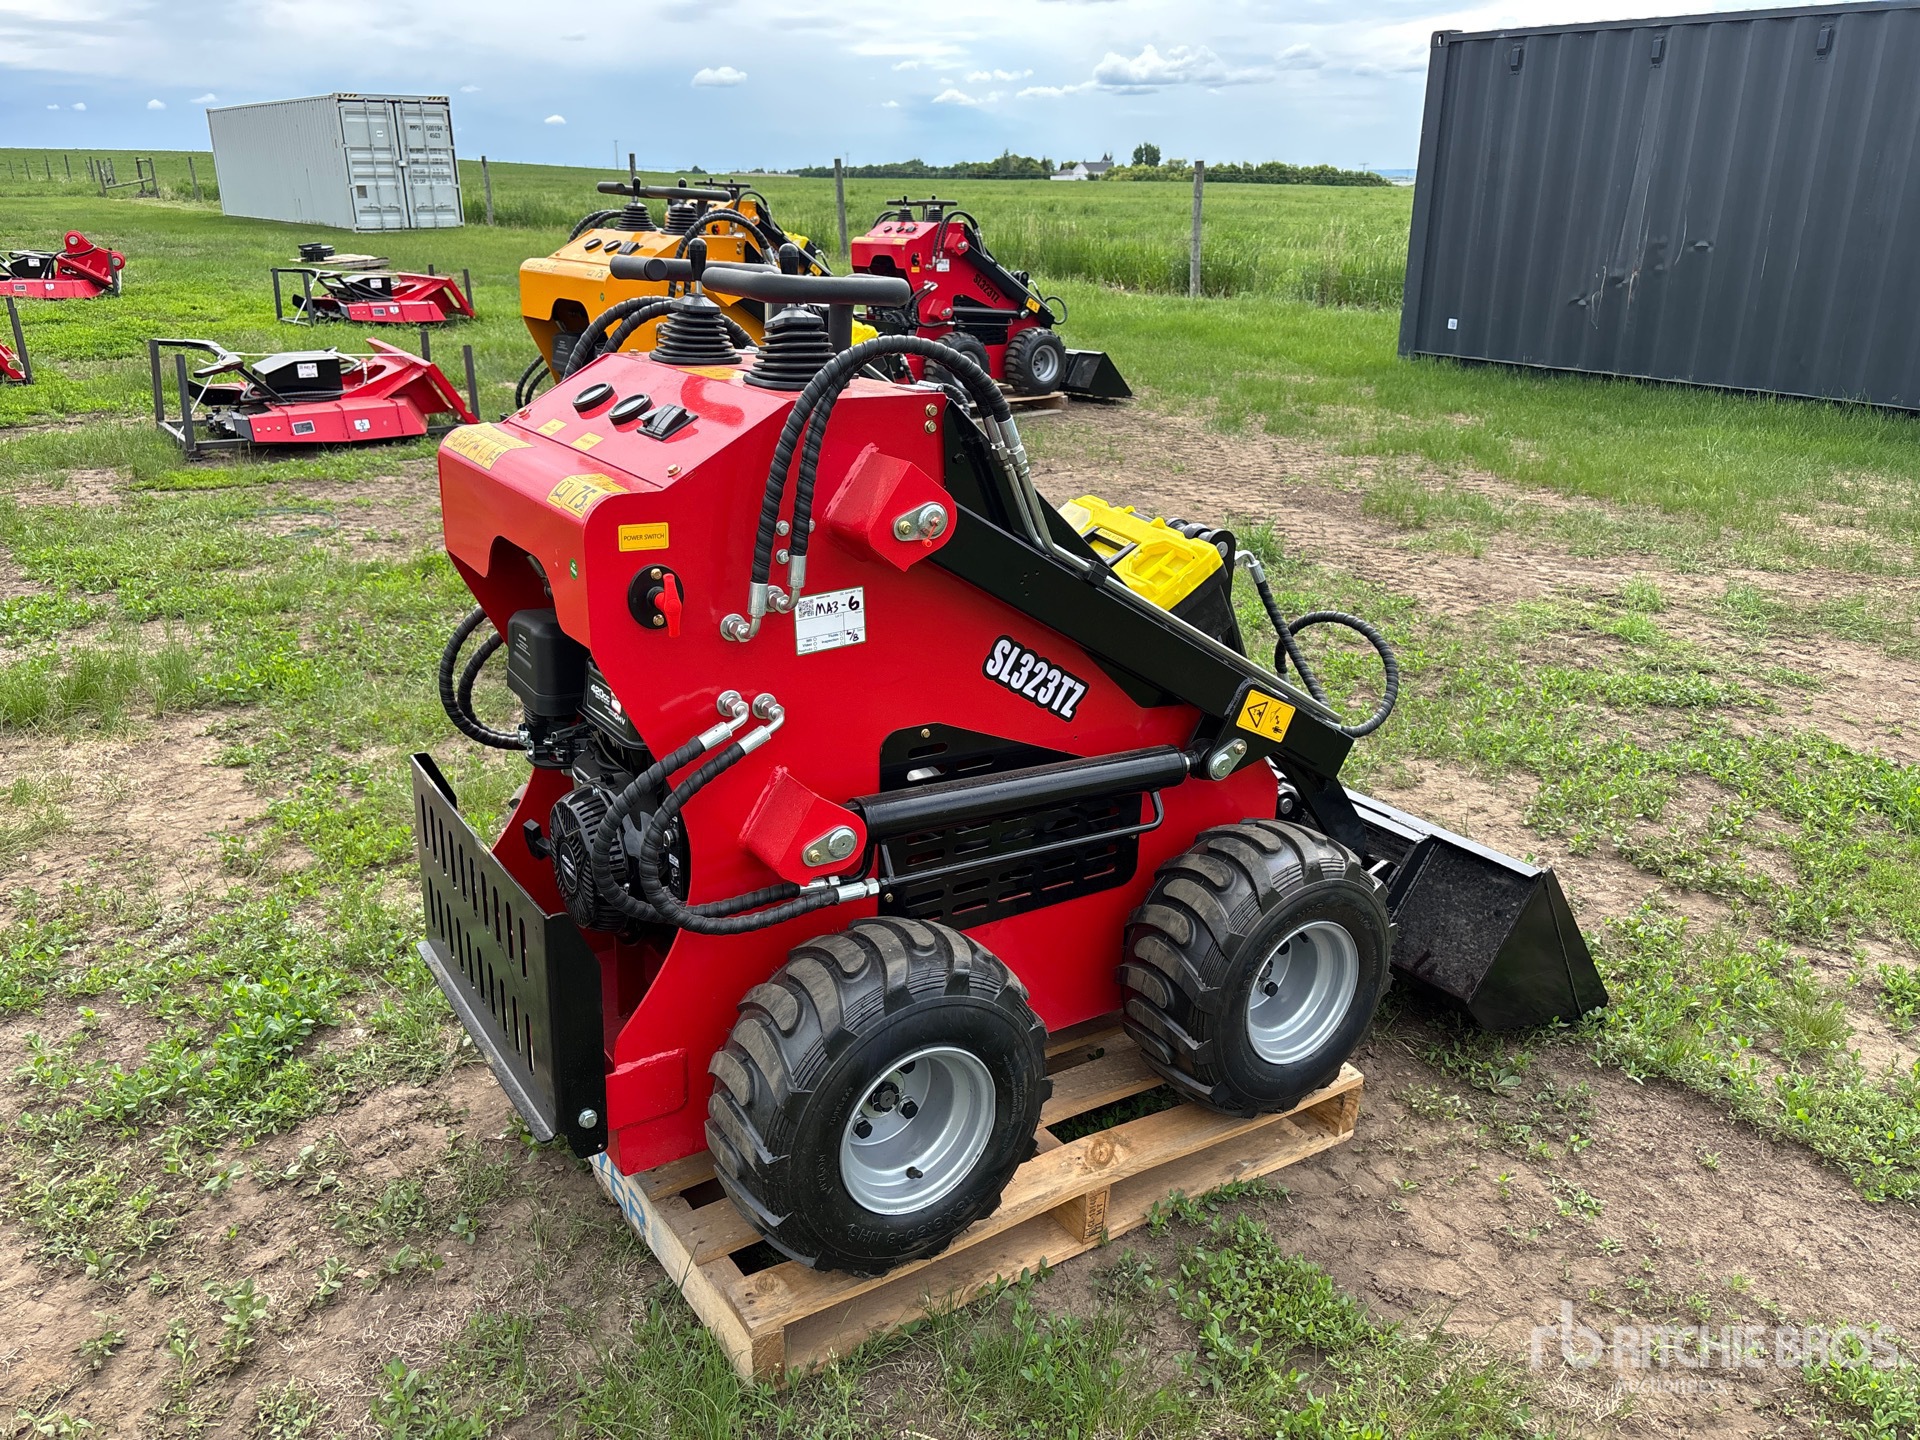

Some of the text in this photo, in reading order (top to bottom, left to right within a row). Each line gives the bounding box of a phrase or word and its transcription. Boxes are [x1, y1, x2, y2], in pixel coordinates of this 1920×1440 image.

[973, 273, 1000, 304] SL323TZ
[567, 484, 598, 510] 75
[623, 532, 665, 542] POWER SWITCH
[984, 637, 1087, 720] SL323TZ
[590, 684, 610, 703] 420cc
